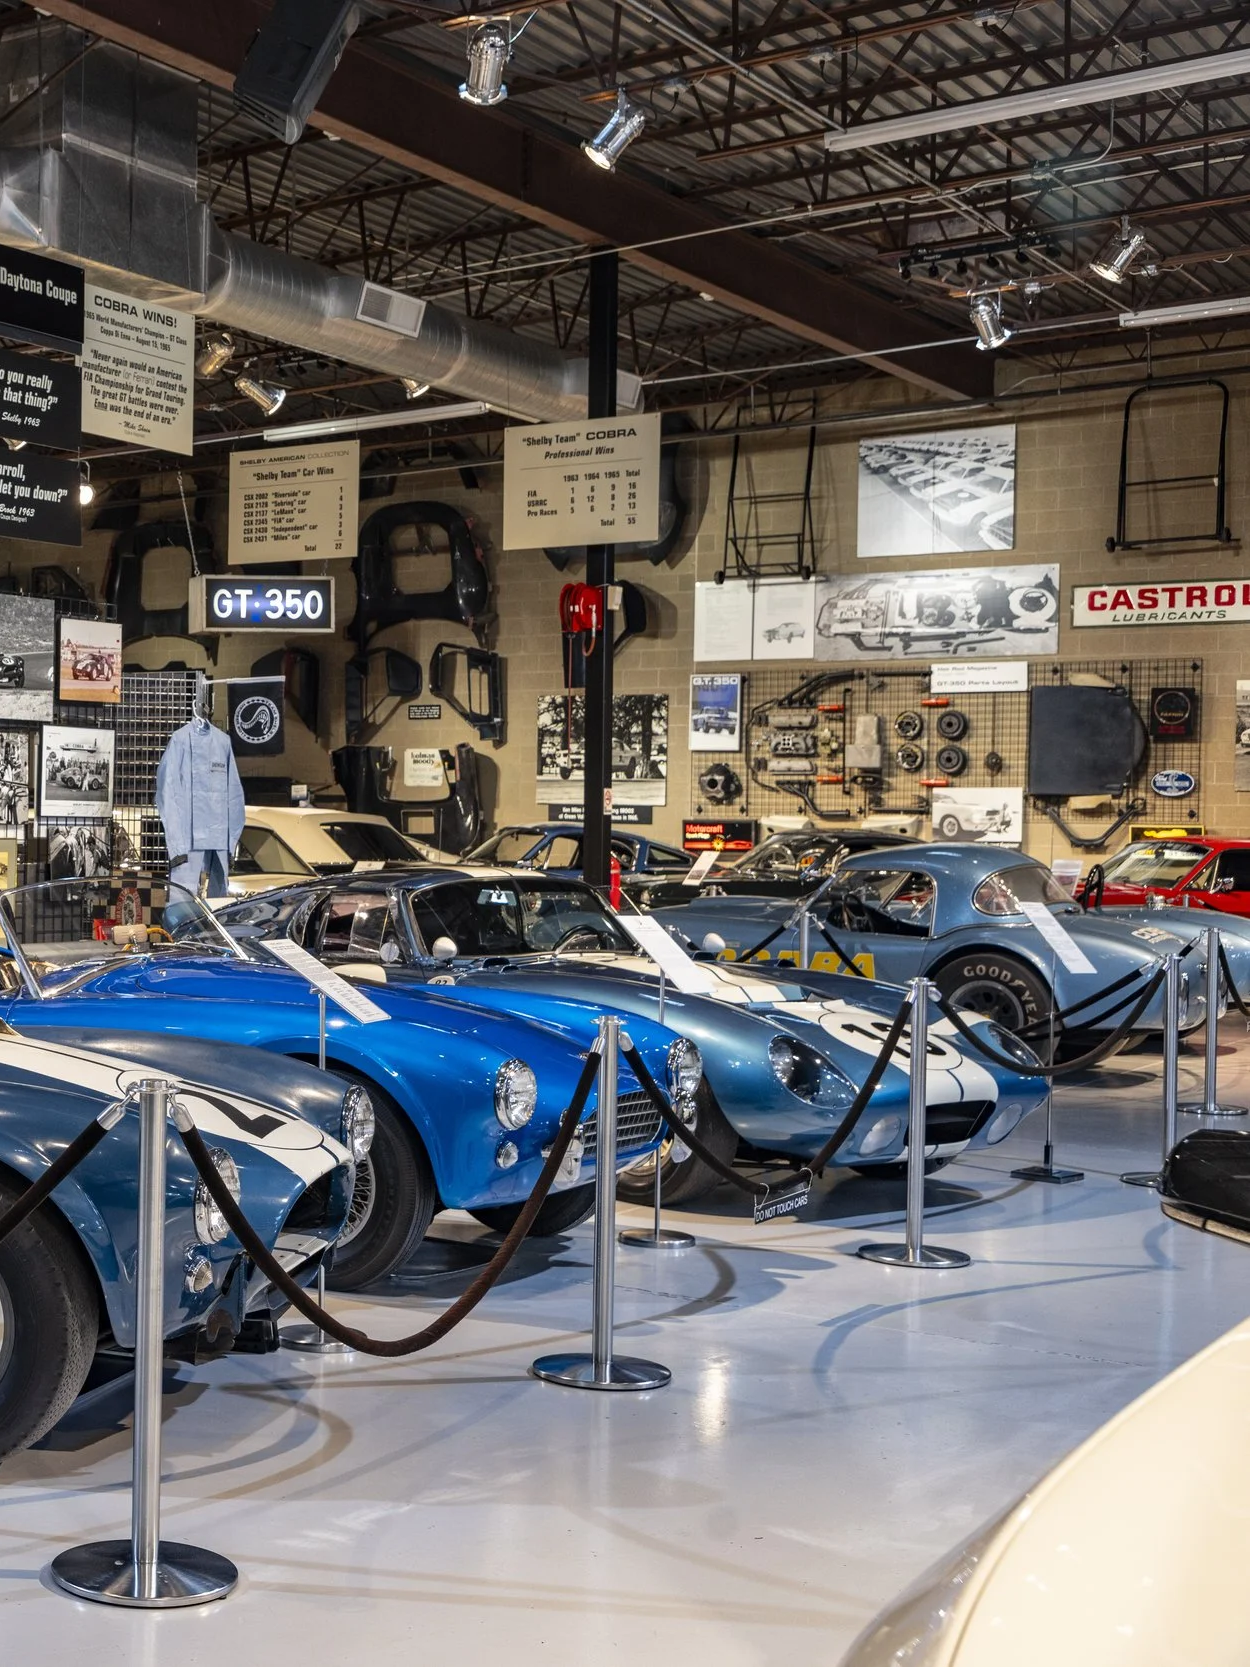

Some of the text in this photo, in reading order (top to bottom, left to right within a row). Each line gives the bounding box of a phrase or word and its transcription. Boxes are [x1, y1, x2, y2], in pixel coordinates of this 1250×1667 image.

[0, 266, 43, 296] Daytona
[46, 280, 77, 306] Coupe
[94, 294, 178, 329] COBRA WINS!
[7, 369, 24, 387] you
[26, 371, 53, 394] really
[3, 387, 23, 405] that
[586, 428, 637, 441] COBRA
[239, 454, 306, 466] SHELBY AMERICAN
[544, 446, 615, 460] Professional Wins
[303, 468, 314, 478] Car
[316, 466, 335, 476] Wins
[14, 484, 30, 500] you
[1111, 609, 1227, 622] LUBRICANTS
[685, 824, 723, 834] Motorcraft
[963, 964, 1038, 1026] GOODYEA
[756, 1195, 808, 1222] DO NOT TOUCH CARS
